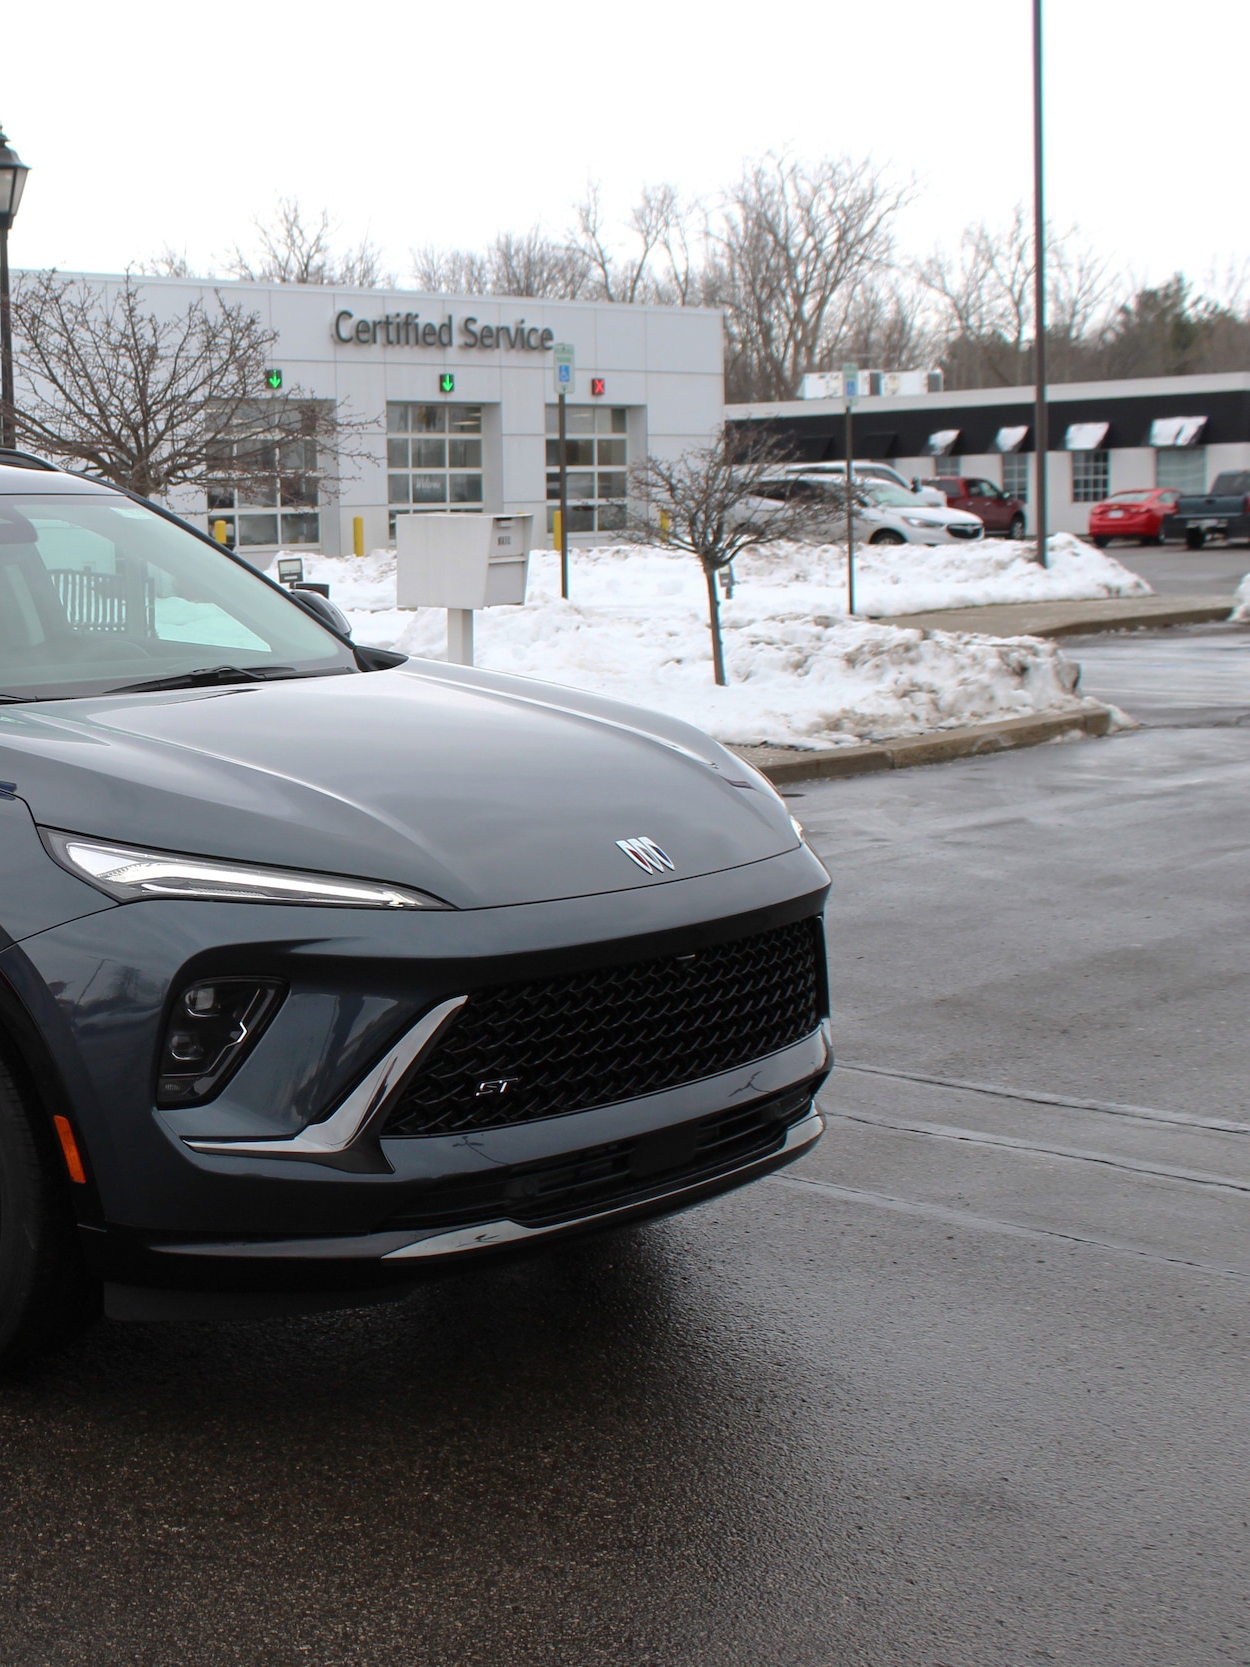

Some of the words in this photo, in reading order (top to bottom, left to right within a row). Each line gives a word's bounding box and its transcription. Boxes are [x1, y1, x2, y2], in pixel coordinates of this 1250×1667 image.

[335, 309, 453, 347] Certified
[464, 316, 554, 350] Service
[475, 1077, 519, 1096] ST
